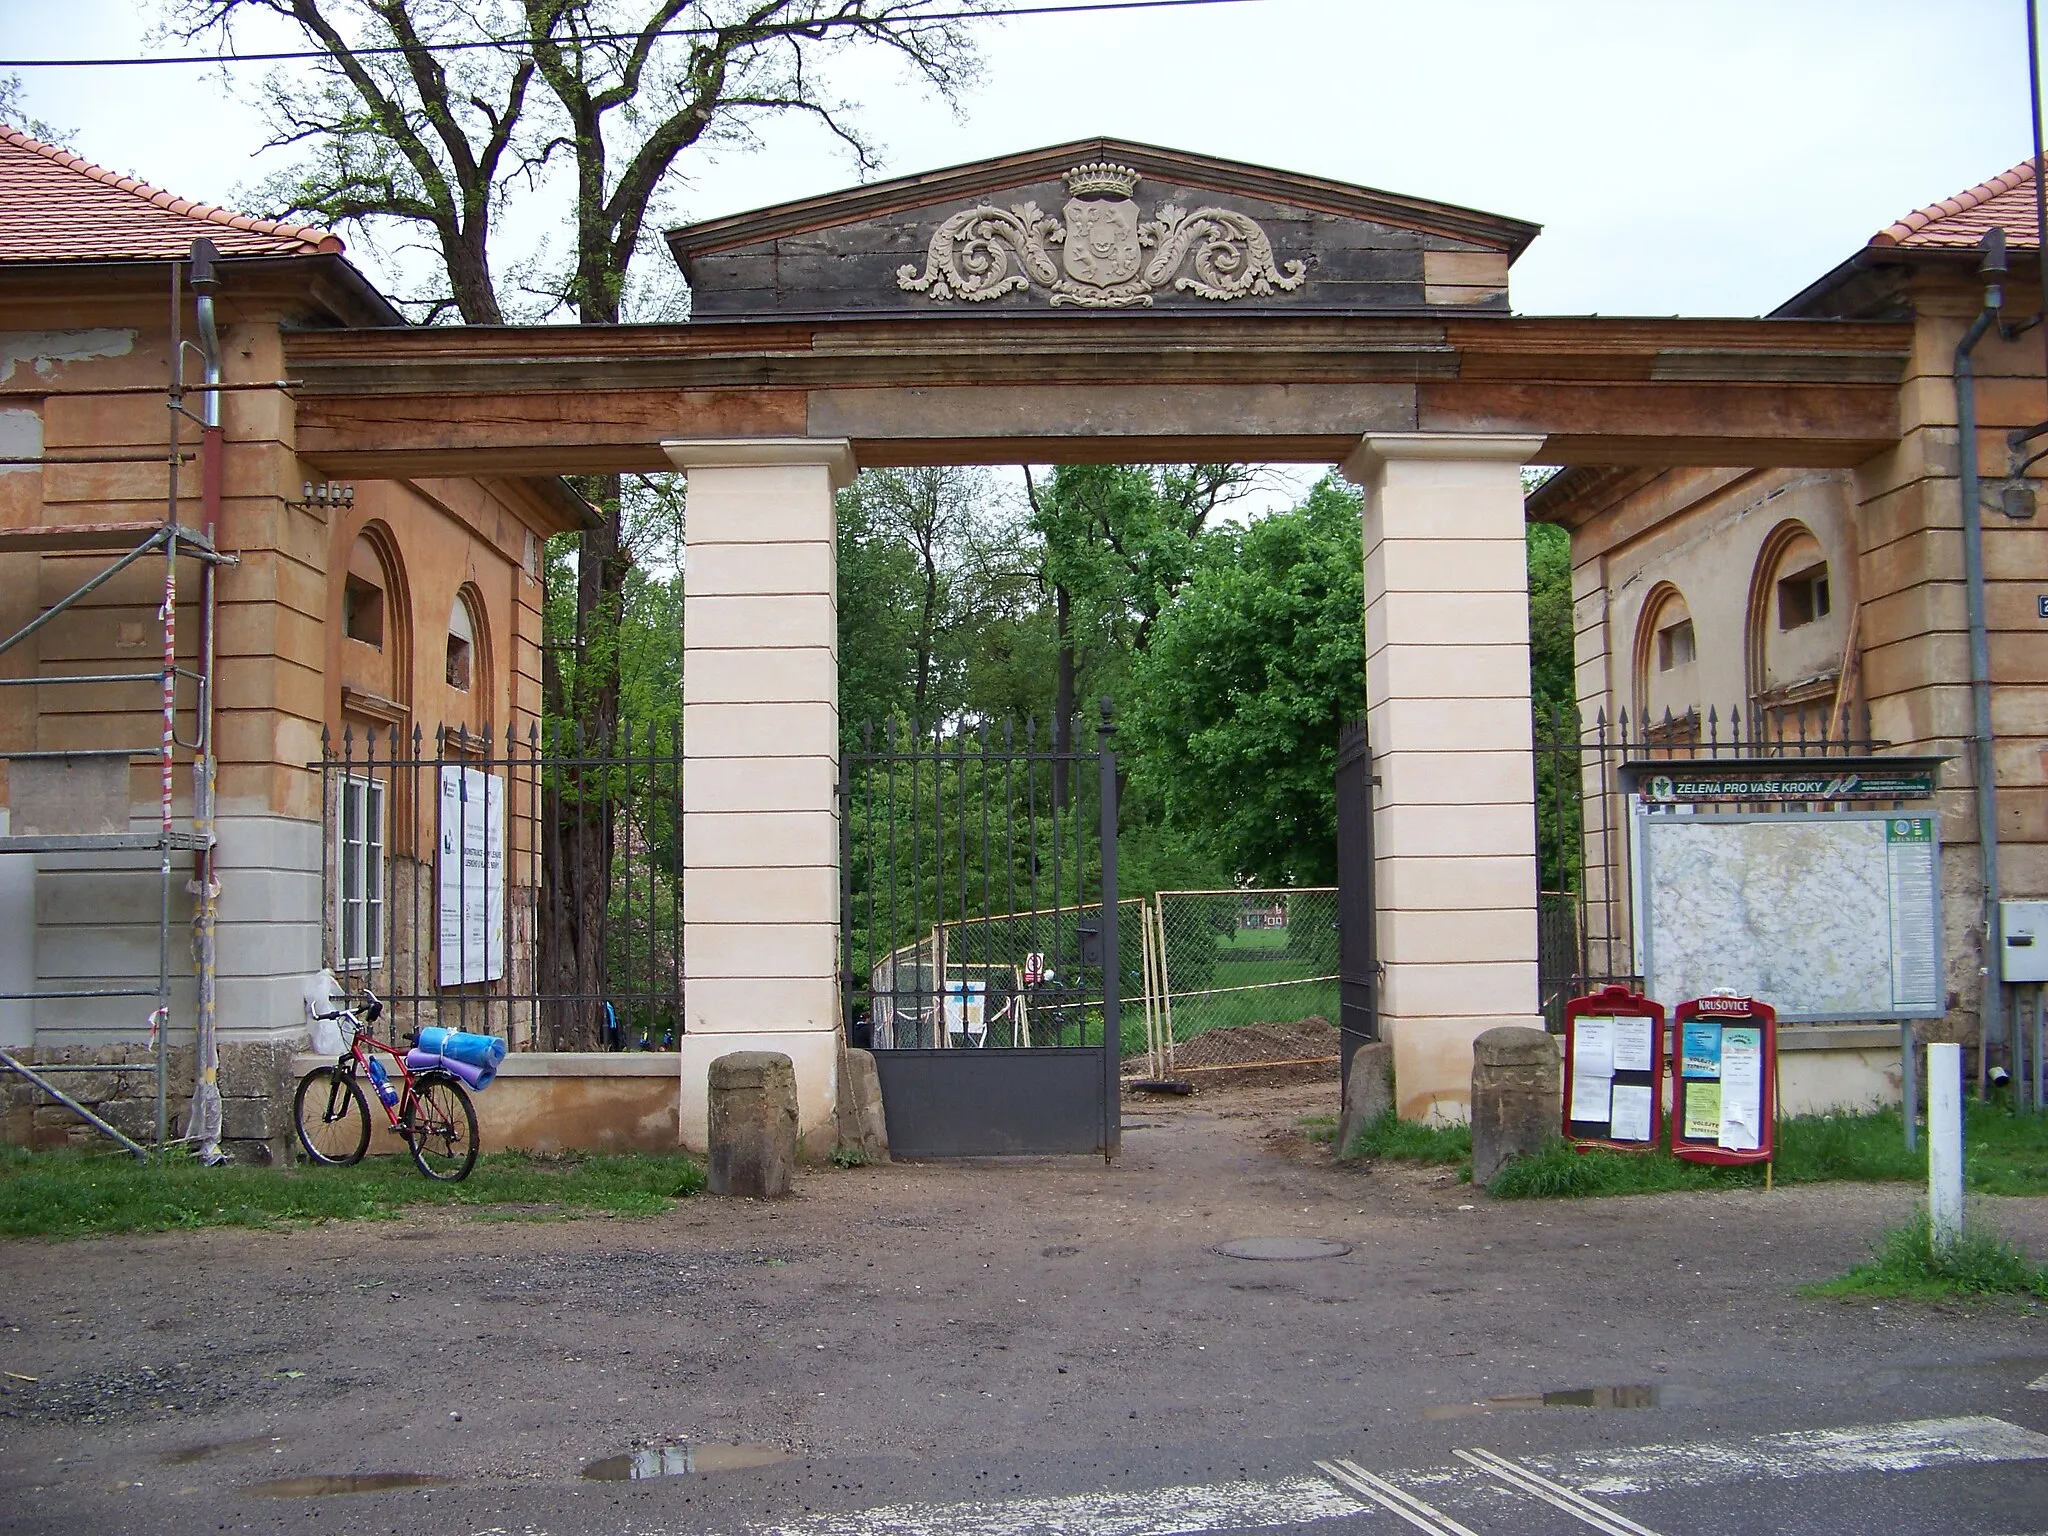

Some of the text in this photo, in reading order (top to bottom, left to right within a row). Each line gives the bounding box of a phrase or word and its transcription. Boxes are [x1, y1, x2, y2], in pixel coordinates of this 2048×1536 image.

[1677, 782, 1823, 794] ZELENÁ PRO VAŠE KROKY
[1698, 999, 1749, 1011] KRUŠOVICE
